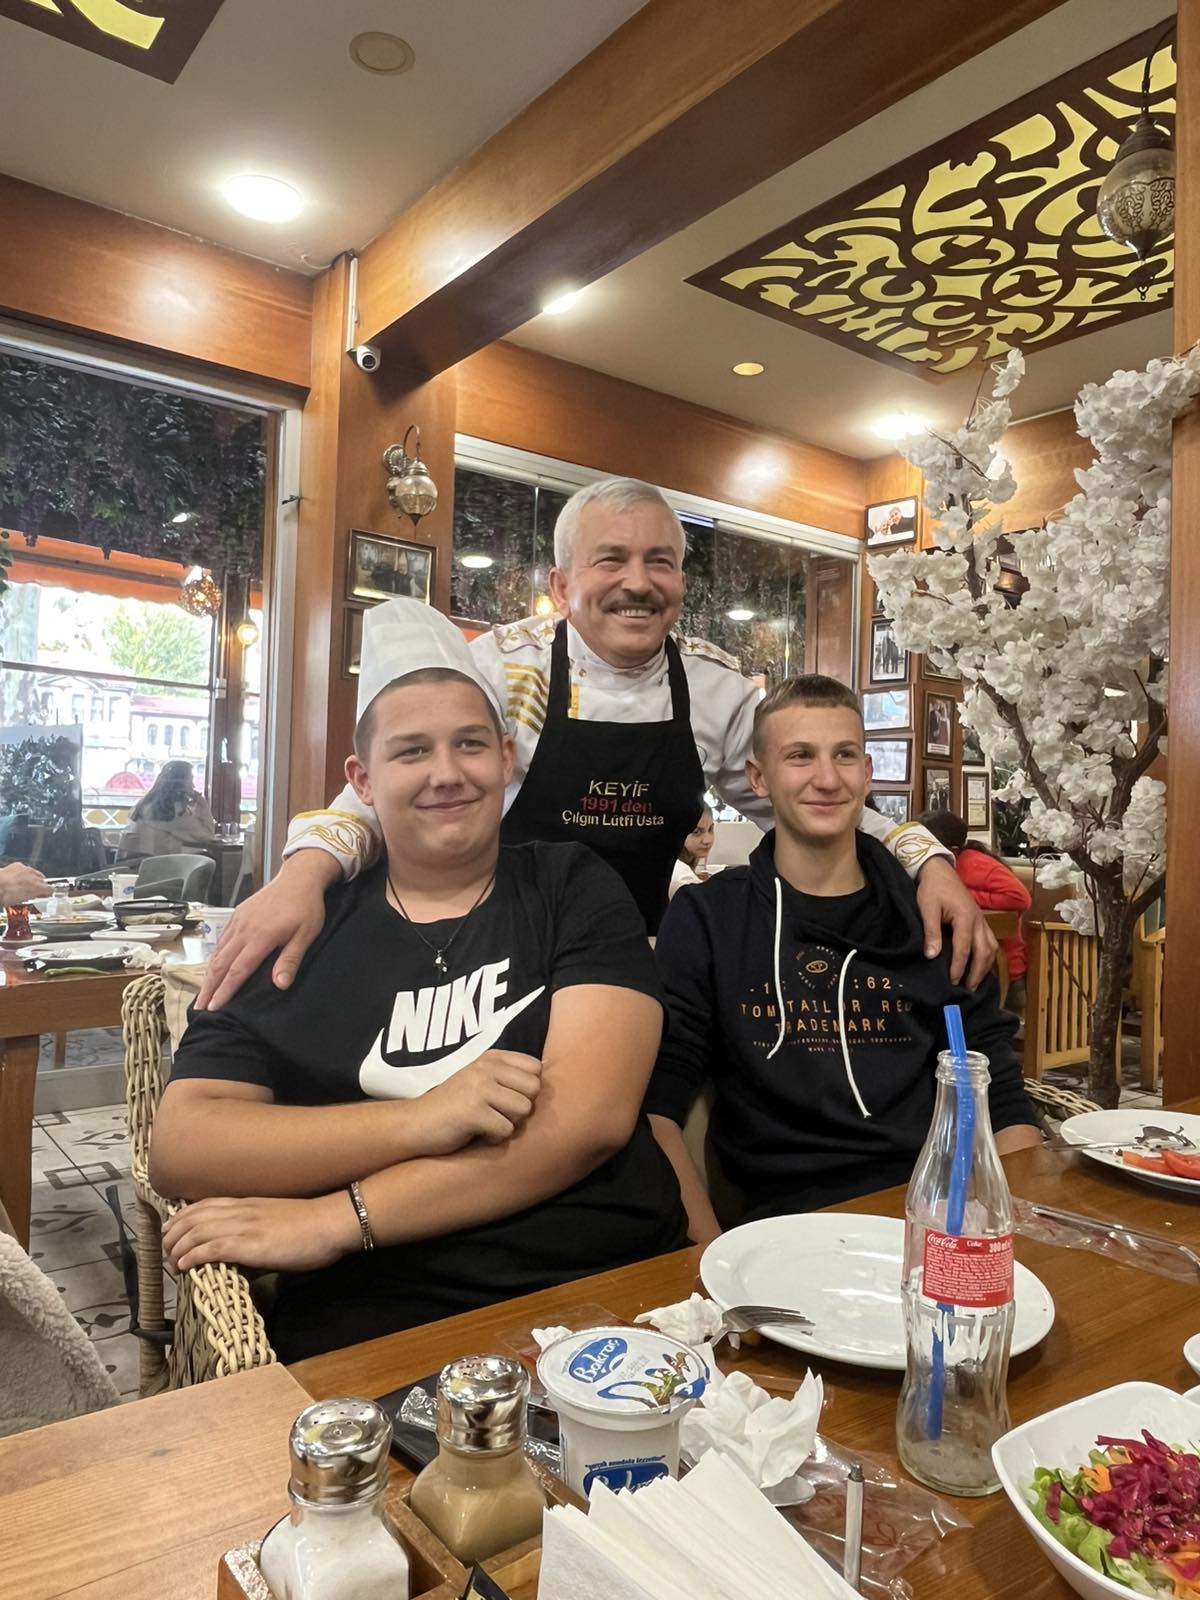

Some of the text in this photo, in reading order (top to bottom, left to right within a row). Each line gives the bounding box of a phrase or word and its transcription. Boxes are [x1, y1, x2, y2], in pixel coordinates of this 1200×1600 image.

[588, 780, 650, 797] KEYİF
[580, 797, 618, 813] 1991
[562, 809, 599, 827] Çılgın
[636, 815, 664, 827] Usta
[386, 957, 510, 1054] NIKE
[740, 1003, 777, 1019] TOM
[787, 999, 862, 1014] TAILR
[927, 1233, 959, 1249] Coca-Cola
[573, 1339, 620, 1383] Bakraç
